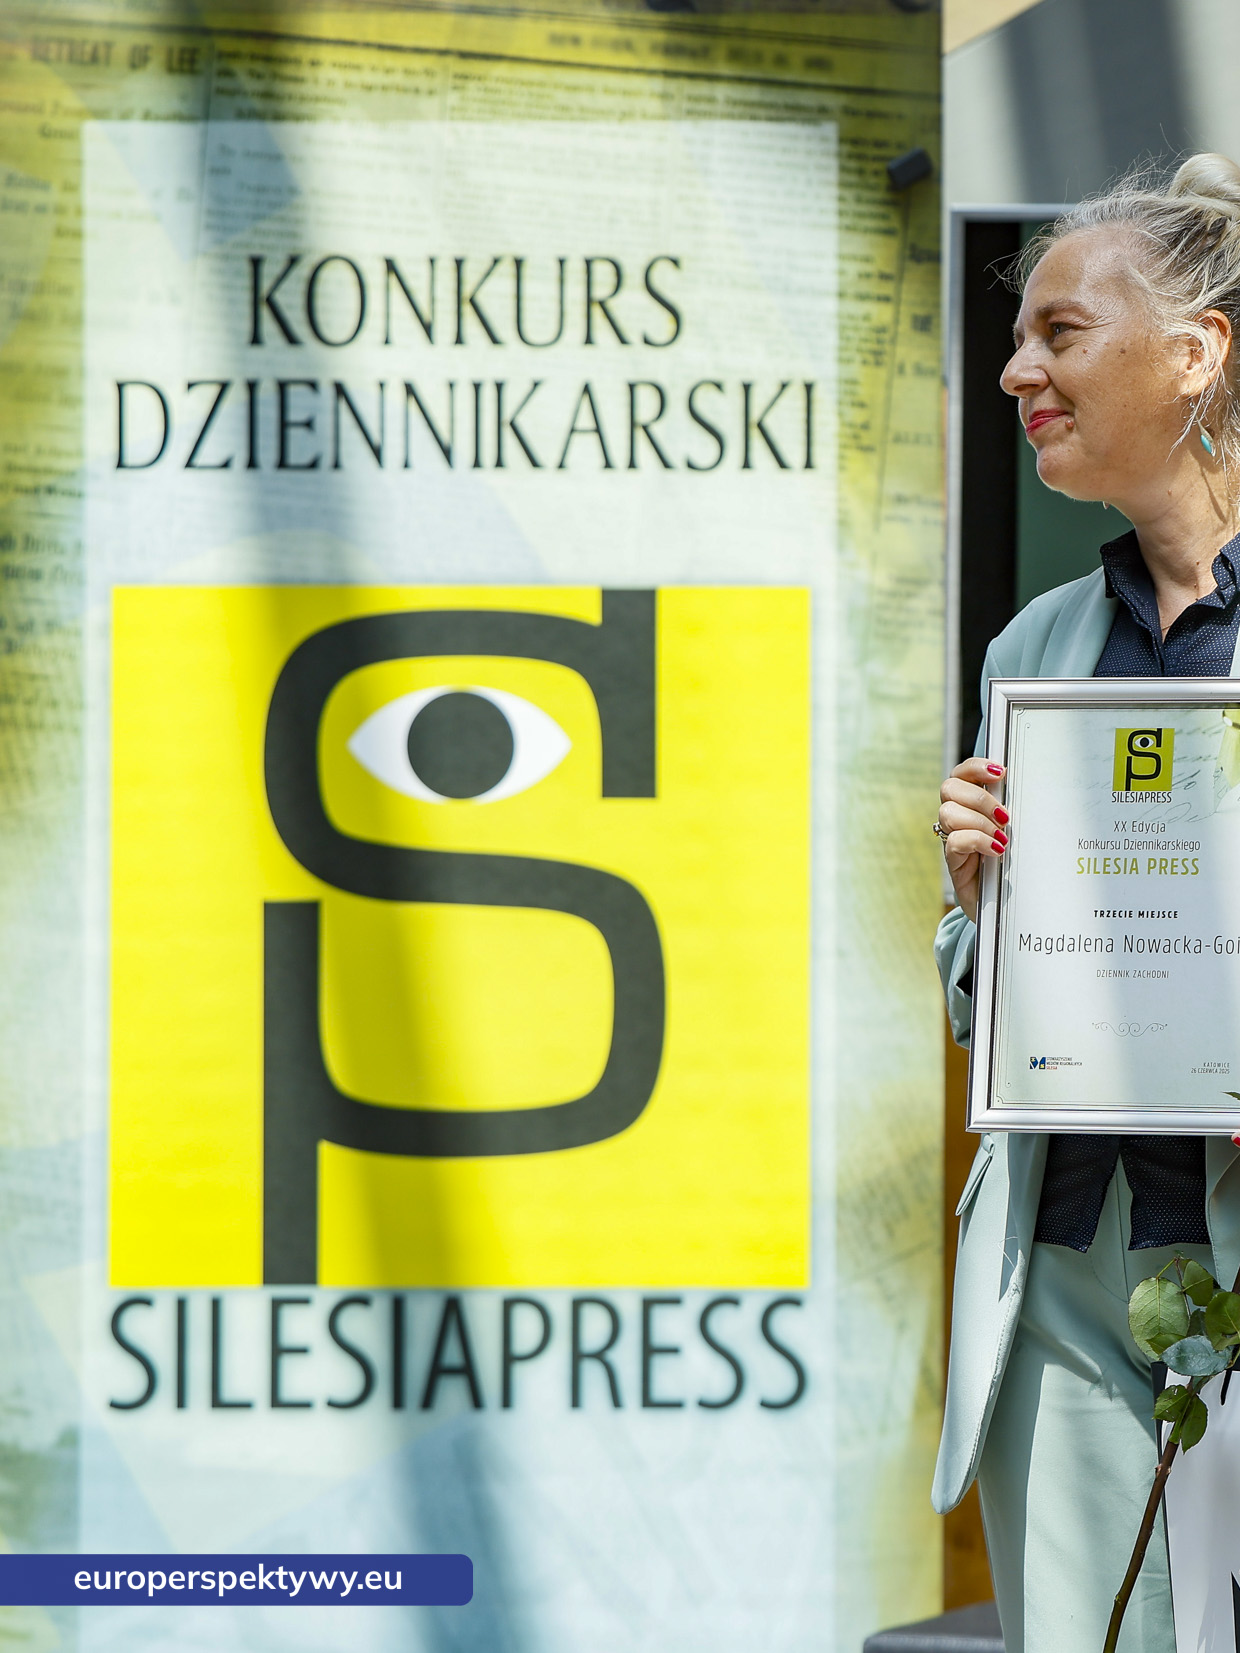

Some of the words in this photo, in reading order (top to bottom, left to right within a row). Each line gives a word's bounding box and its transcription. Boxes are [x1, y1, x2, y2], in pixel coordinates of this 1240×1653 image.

[248, 255, 684, 347] KONKURS
[114, 380, 817, 470] DZIENNIKARSKI
[1111, 791, 1172, 803] SILESIAPRESS
[1113, 821, 1127, 832] XX
[1131, 821, 1166, 834] Edycja
[1078, 838, 1121, 850] Konkursu
[1123, 838, 1201, 852] Dziennikarskiego
[1076, 857, 1139, 875] SILESIA
[1147, 857, 1200, 876] PRESS
[1093, 910, 1133, 918] TRZECIE
[1138, 910, 1179, 919] MIEJSCE
[1018, 933, 1114, 955] Magdalena
[1096, 969, 1130, 978] DZIENNIK
[1132, 969, 1169, 979] ZACHODNI
[107, 1295, 812, 1411] SILESIAPRESS
